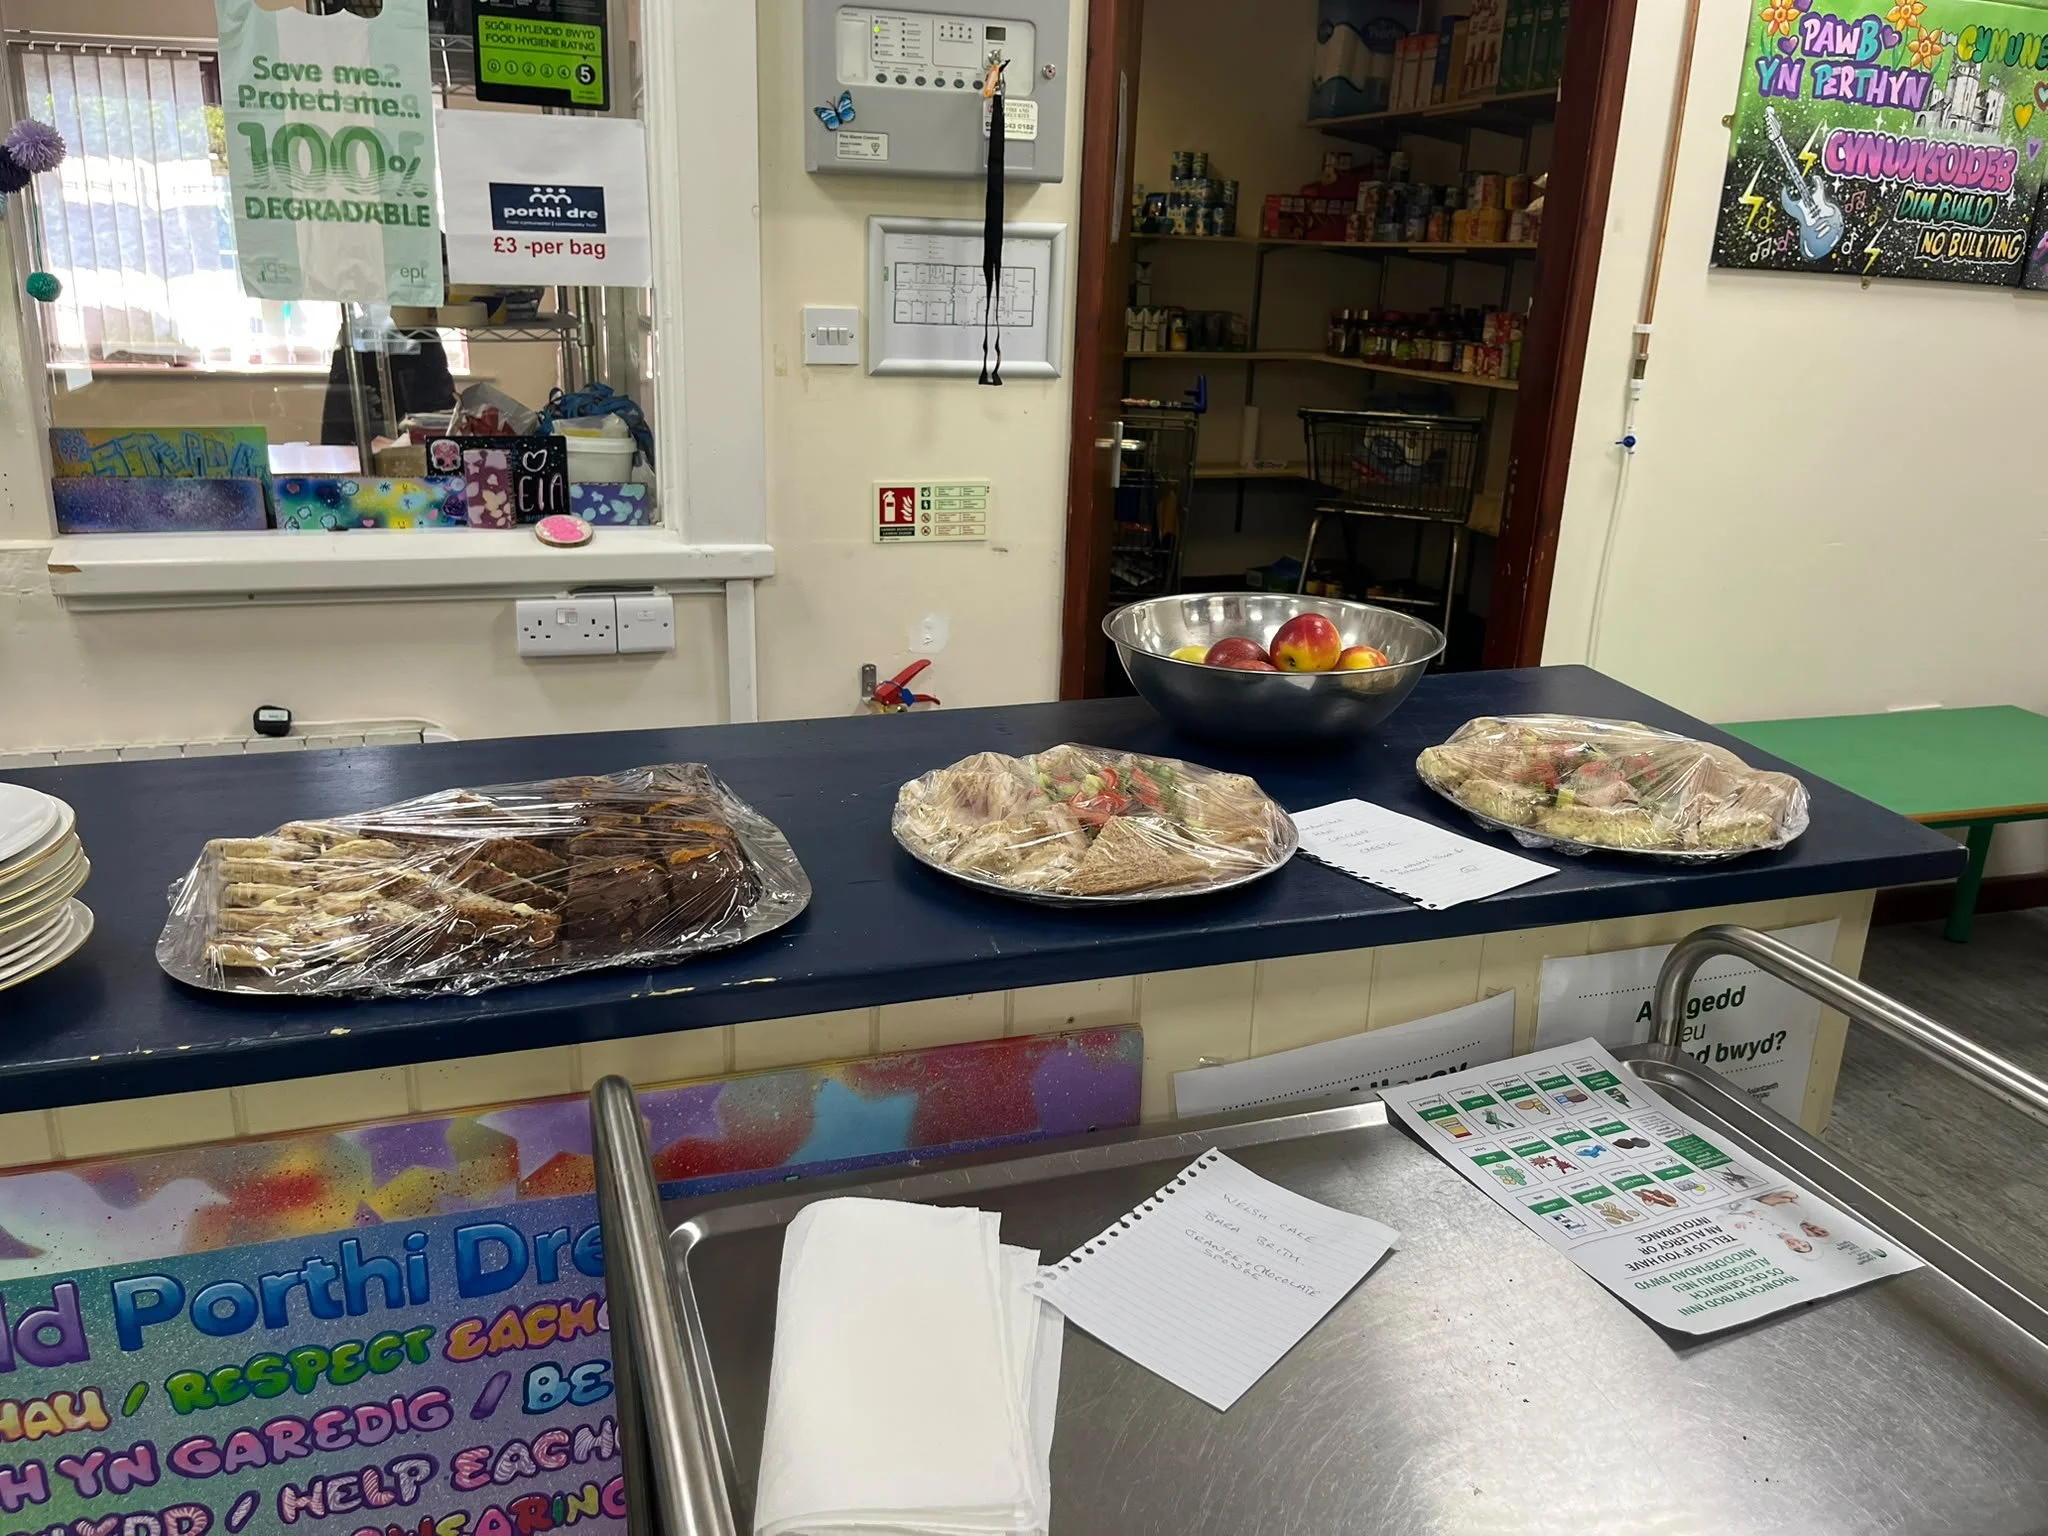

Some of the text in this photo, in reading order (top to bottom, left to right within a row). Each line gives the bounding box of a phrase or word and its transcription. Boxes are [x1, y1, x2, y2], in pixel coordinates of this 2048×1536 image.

[485, 33, 595, 52] FOOD HYGIENE RATING
[515, 23, 563, 36] HYLENDID
[565, 28, 595, 40] BWYD
[1803, 18, 1880, 61] PAWB
[253, 55, 323, 83] Save
[580, 66, 591, 83] 5
[1758, 59, 1928, 110] YN PERTHYN
[237, 121, 429, 198] 100%
[1825, 130, 2018, 191] CYNWYSOLDEB
[244, 197, 431, 227] DEGRADABLE
[503, 206, 598, 219] porthi dre
[1900, 188, 1997, 227] DIM BWLIO
[493, 236, 518, 254] £3
[570, 238, 606, 260] bag
[1920, 232, 2024, 260] NO BULLYING
[1715, 1030, 1787, 1063] bwyd?
[1204, 1210, 1241, 1233] BARA
[1224, 1193, 1317, 1244] WELSH CAKE
[1633, 1215, 1712, 1244] INTOLERANCE
[1624, 1233, 1738, 1271] TELL US IF YOU HAVE
[1637, 1224, 1724, 1255] AN ALLERGY OR
[109, 1231, 431, 1352] Porthi
[453, 1221, 607, 1300] Dre
[1632, 1248, 1759, 1290] ANODDEFIADAU BWYD
[1669, 1256, 1772, 1292] ALERGEDDAU NEU
[1687, 1266, 1785, 1300] OS OES GENNYCH
[1676, 1274, 1800, 1316] RHOWCH WYBOD INNI
[163, 1324, 436, 1415] RESPECT
[442, 1293, 599, 1363] EACH
[54, 1439, 162, 1500] YN
[166, 1386, 456, 1479] GAREDIG
[522, 1360, 616, 1416] BE
[277, 1453, 440, 1525] HELP
[449, 1414, 617, 1491] EACH
